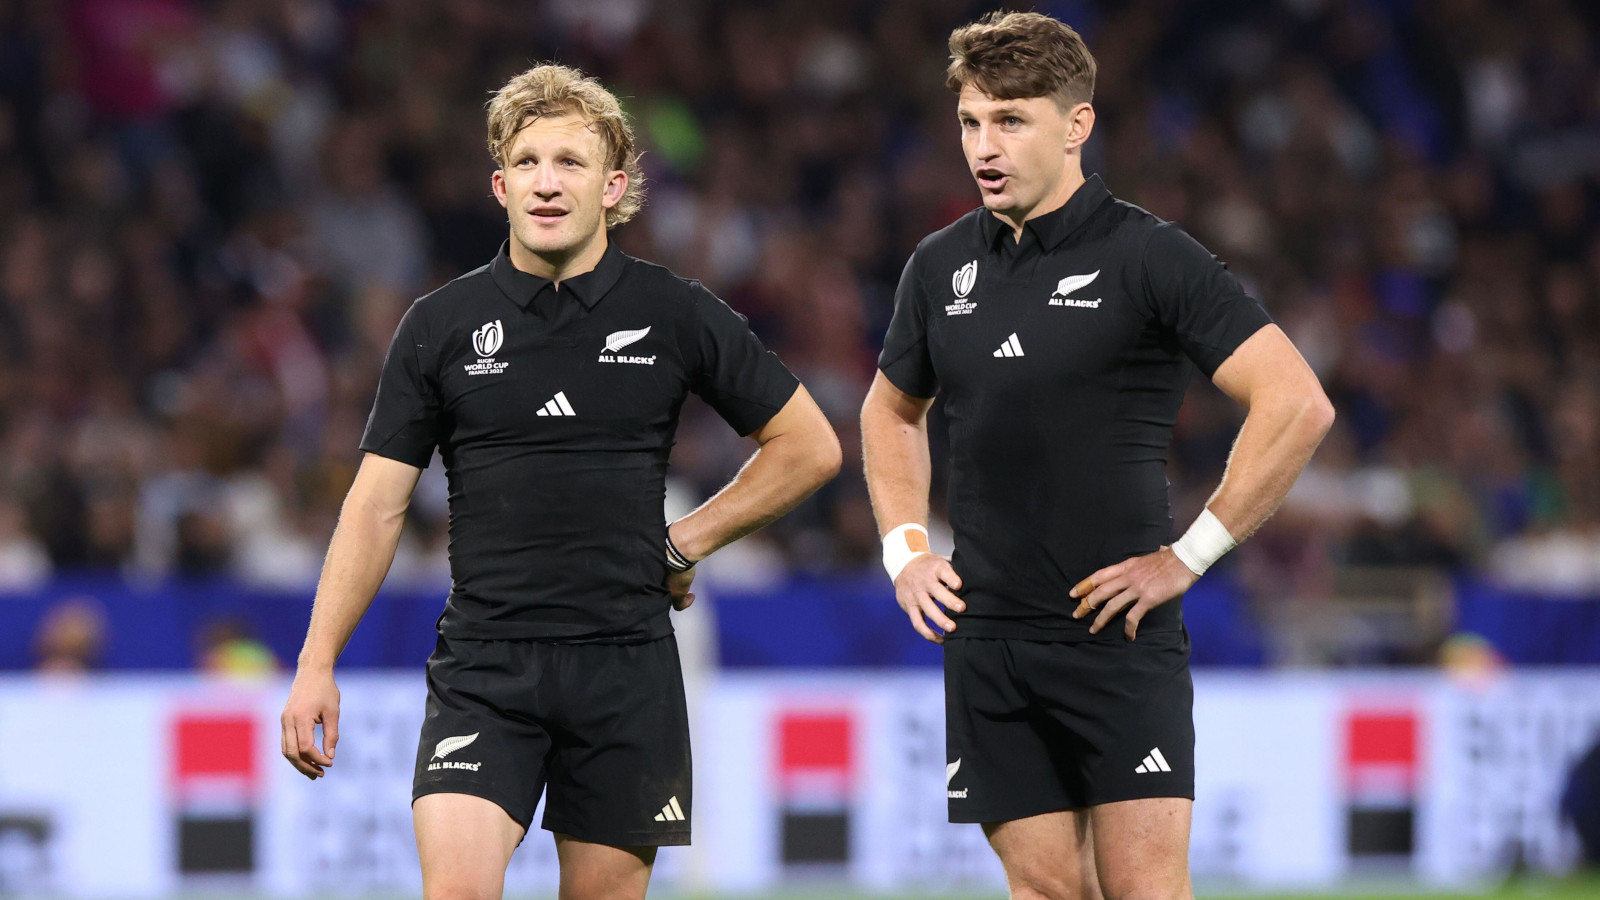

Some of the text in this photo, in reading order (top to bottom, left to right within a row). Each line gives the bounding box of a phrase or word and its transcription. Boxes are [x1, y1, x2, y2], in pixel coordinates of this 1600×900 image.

[1048, 298, 1063, 306] ALL
[945, 303, 965, 312] WORLD
[598, 355, 616, 363] ALL
[464, 363, 492, 371] WORLD
[428, 762, 442, 771] ALL
